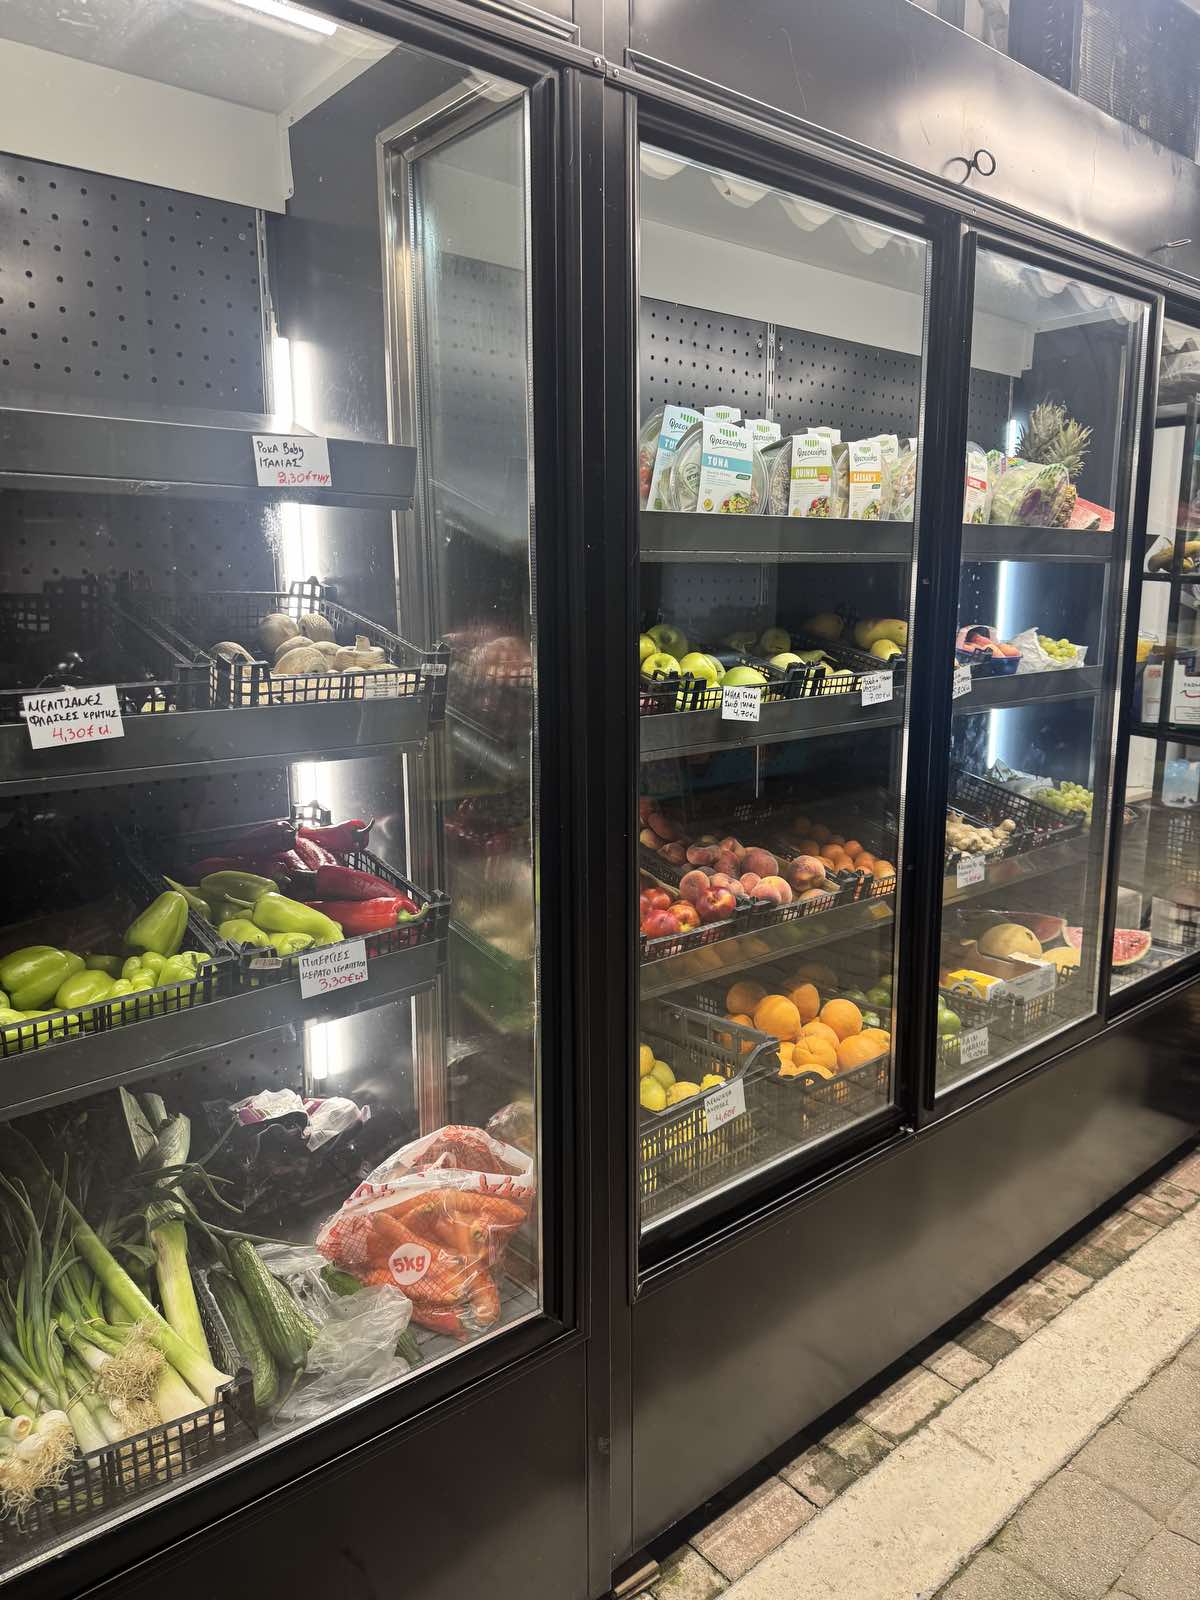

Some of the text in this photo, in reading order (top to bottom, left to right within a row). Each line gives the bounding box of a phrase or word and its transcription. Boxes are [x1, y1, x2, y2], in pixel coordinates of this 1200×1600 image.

[283, 442, 305, 460] Baby
[259, 457, 304, 469] ΙΤΑΛΙΑΣ
[707, 455, 729, 469] TUNA
[28, 709, 119, 727] ΦΛΑΣΚΕΣ ΚΡΗΤΗΣ
[52, 724, 94, 743] 4,30€
[302, 968, 331, 980] ΚΕΡΑΤΟ
[393, 1256, 425, 1273] 5kg
